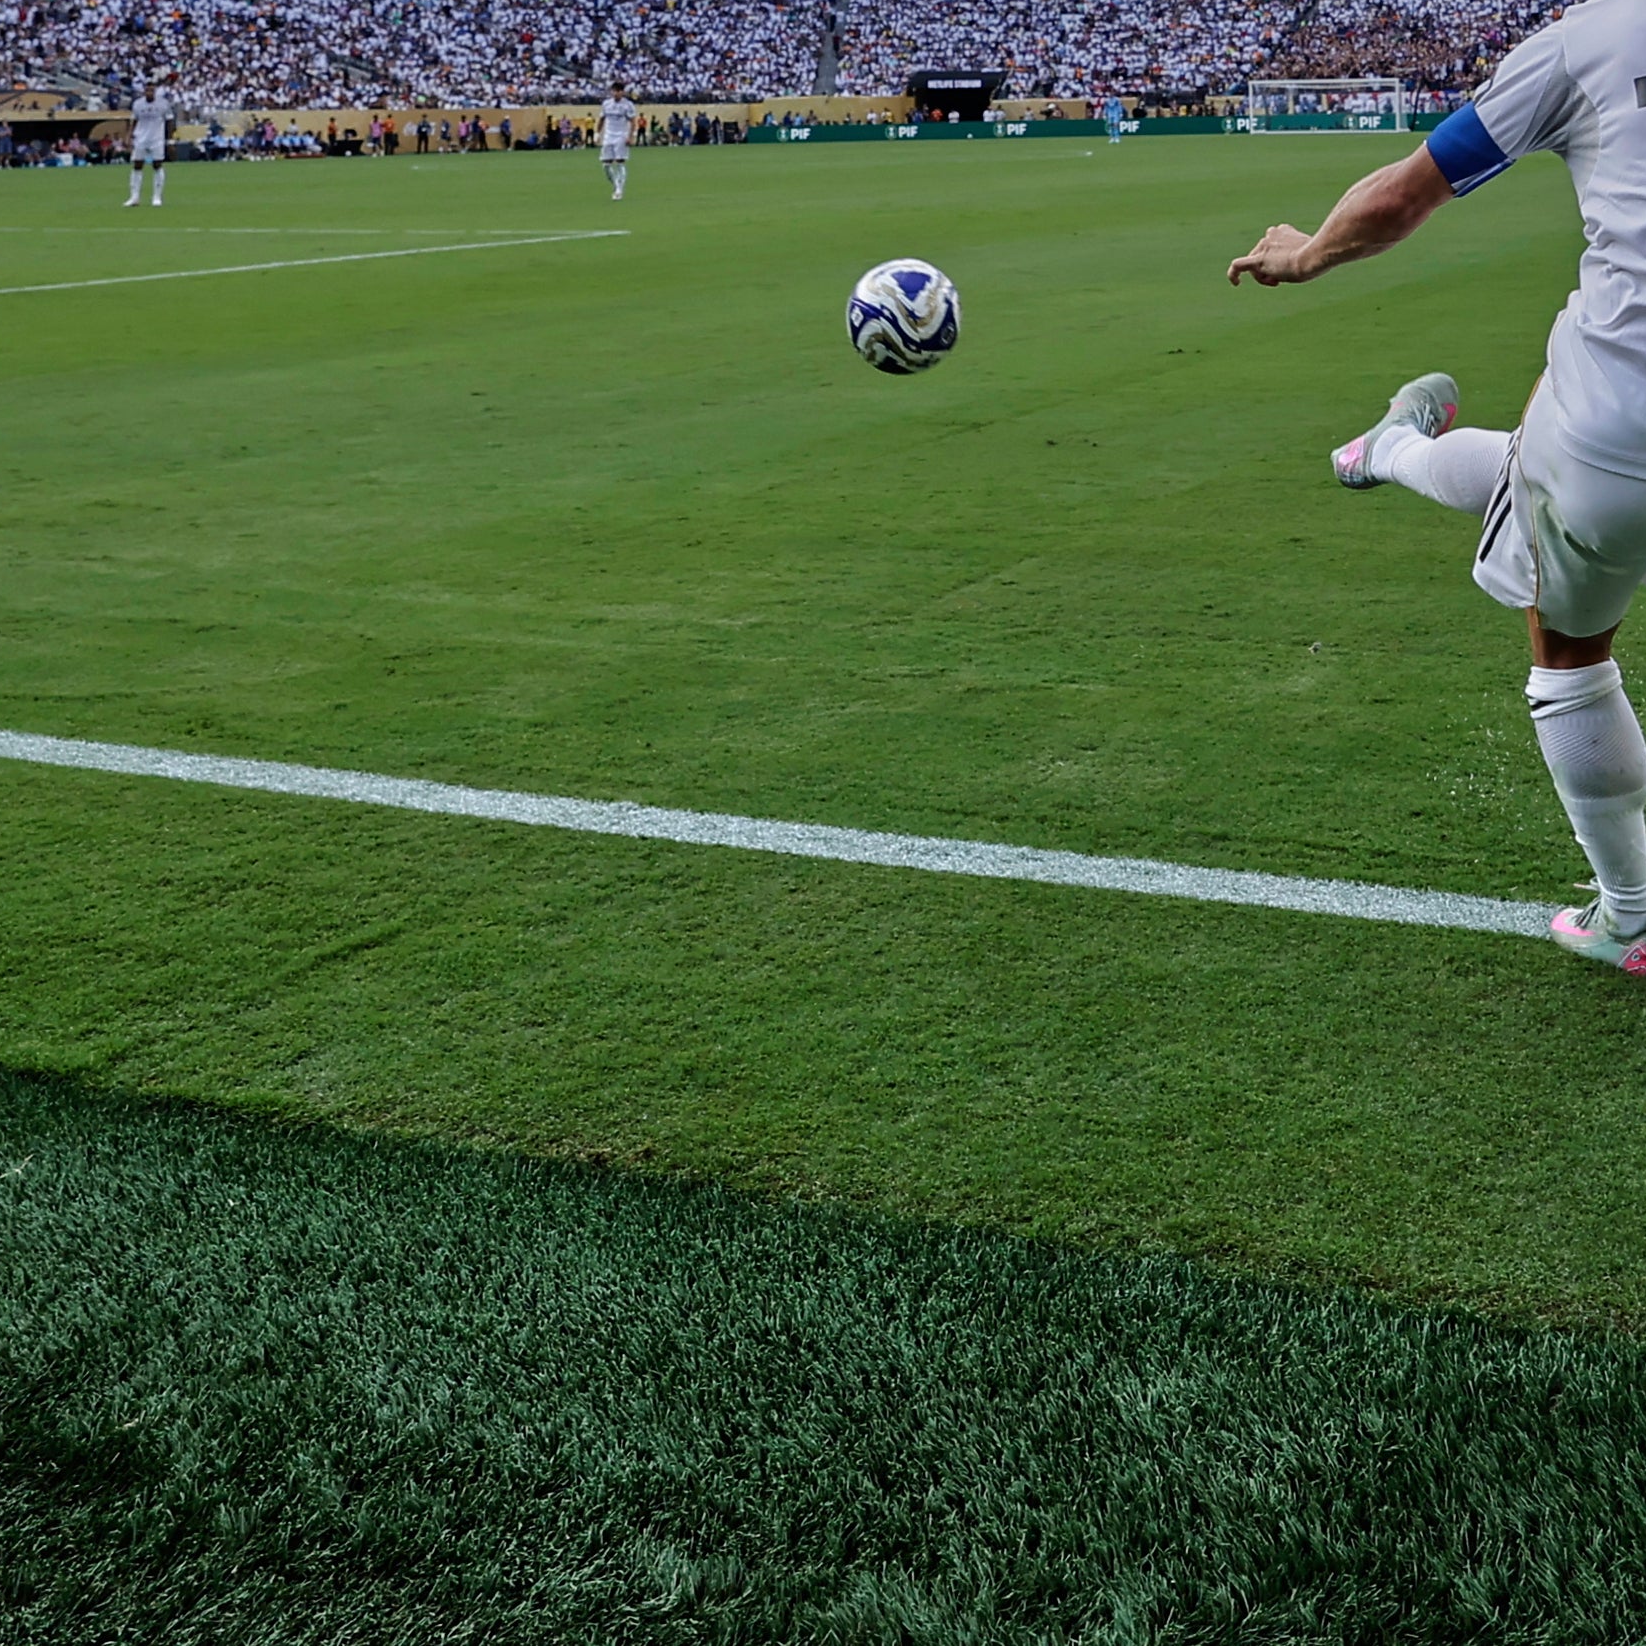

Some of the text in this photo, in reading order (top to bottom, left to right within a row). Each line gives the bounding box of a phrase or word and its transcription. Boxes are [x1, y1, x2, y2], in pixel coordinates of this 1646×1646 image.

[1119, 120, 1141, 134] PIF
[1237, 117, 1257, 132] PIF
[1359, 115, 1382, 130] PIF
[790, 127, 812, 142] PIF
[897, 125, 919, 139] PIF
[1006, 123, 1028, 137] PIF
